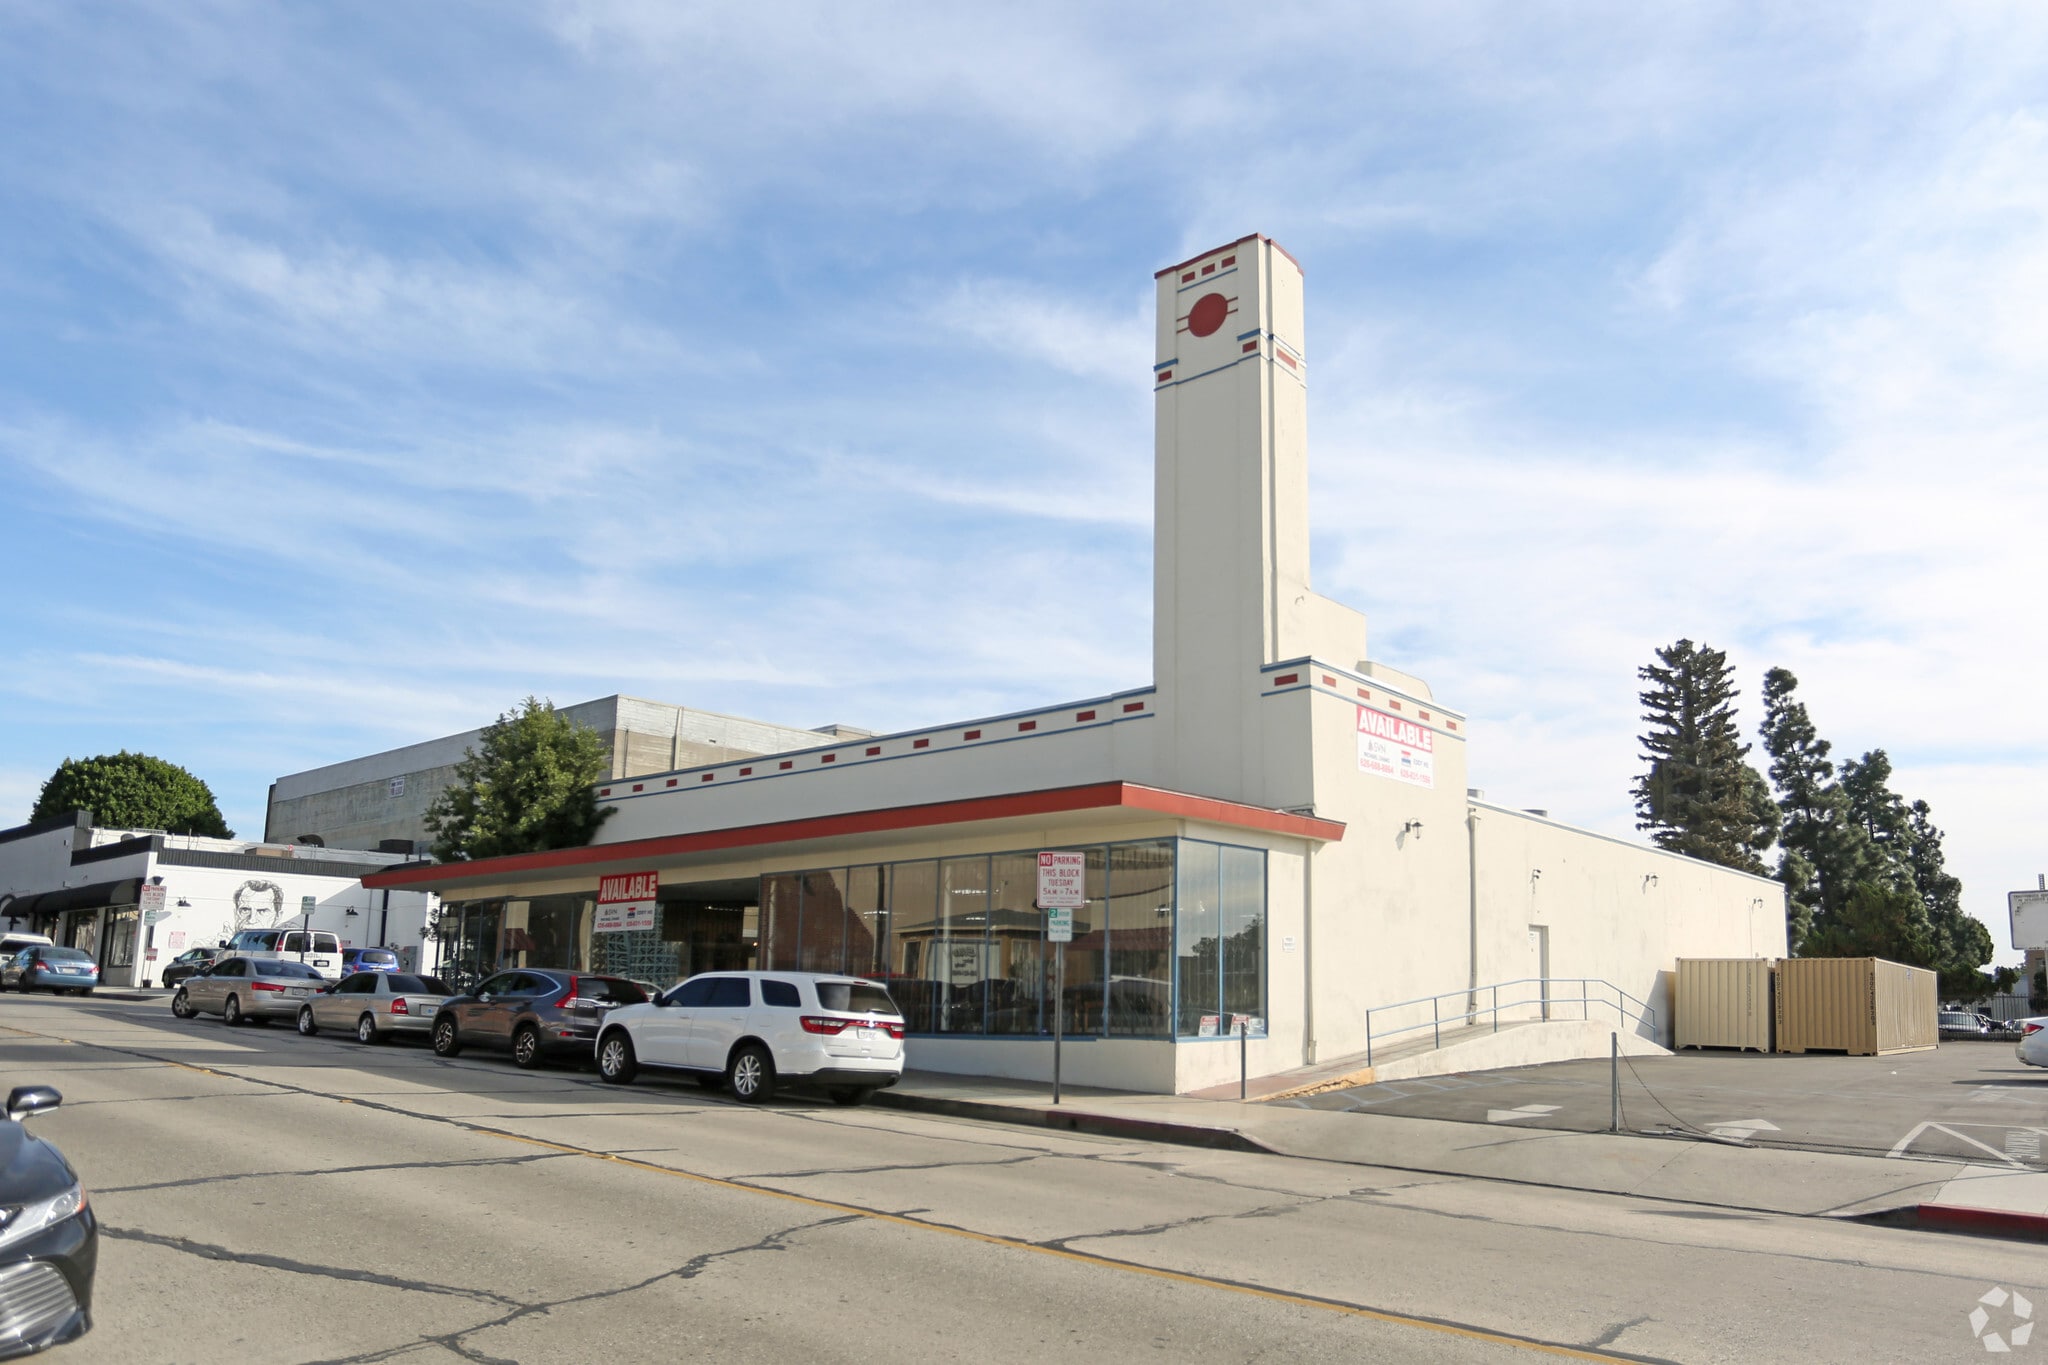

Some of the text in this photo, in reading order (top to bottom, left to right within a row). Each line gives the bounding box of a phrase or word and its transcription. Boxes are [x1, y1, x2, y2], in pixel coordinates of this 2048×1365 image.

[1359, 709, 1432, 752] AVAILABLE
[1041, 854, 1081, 865] NO PARKING
[1043, 869, 1080, 877] THIS BLOCK
[600, 874, 657, 902] AVAILABLE
